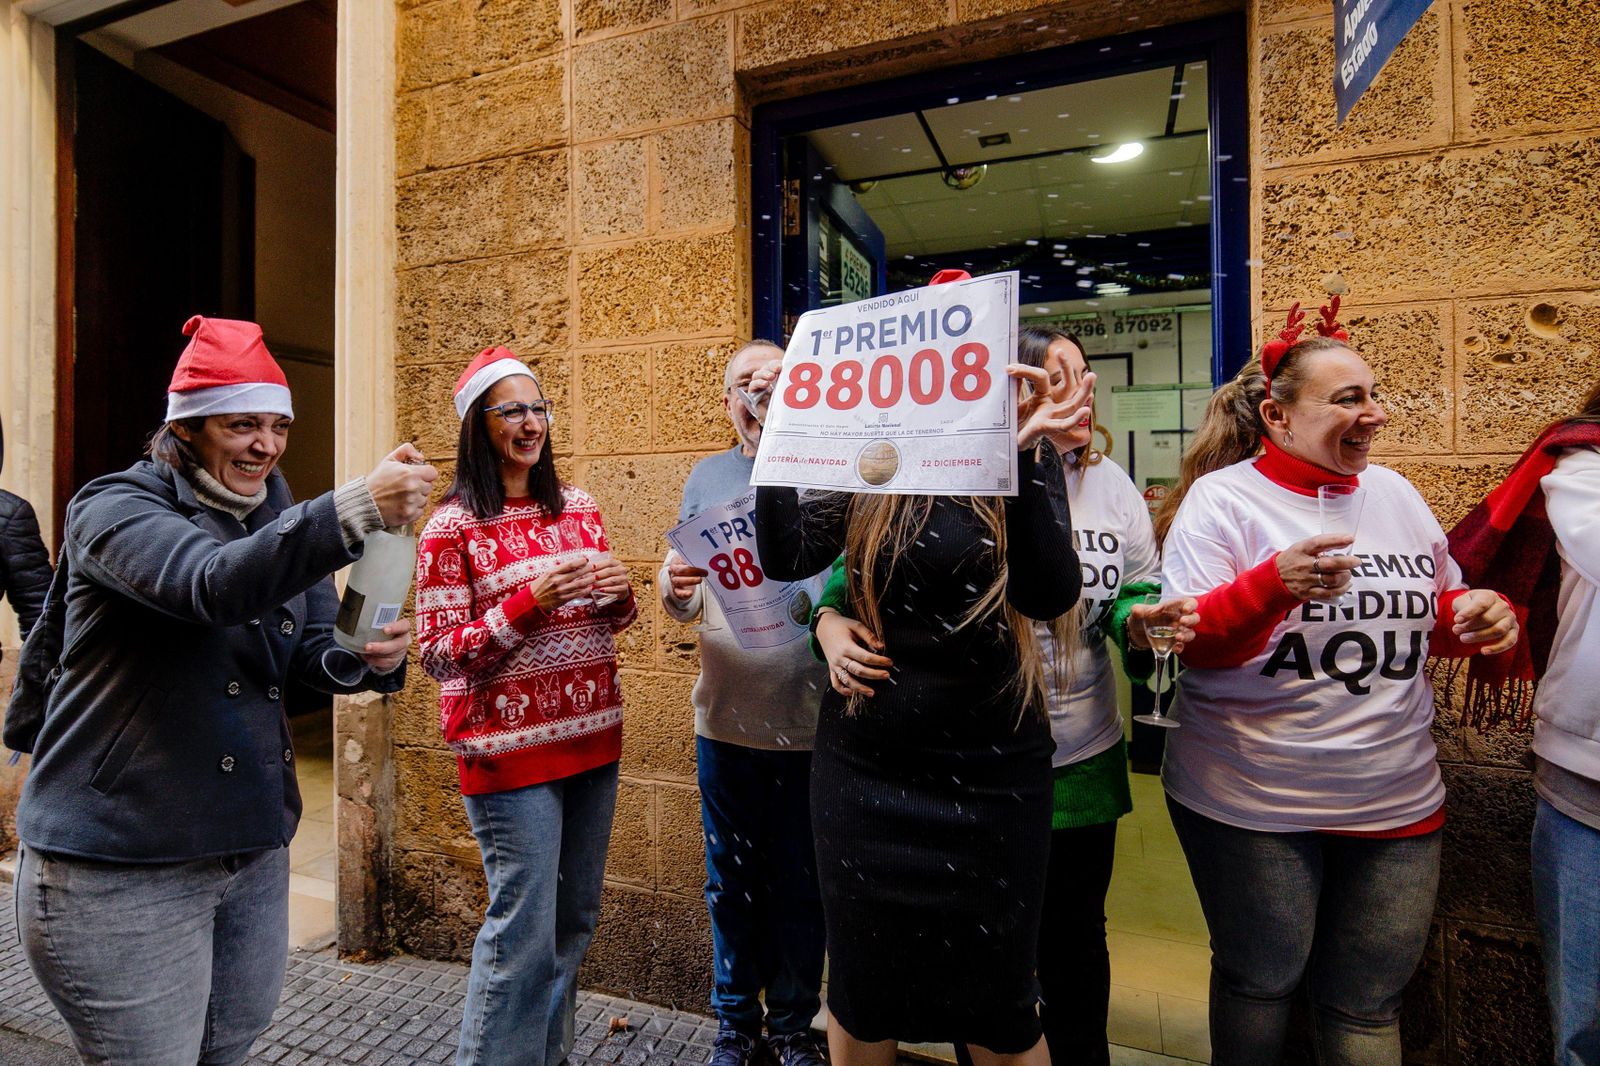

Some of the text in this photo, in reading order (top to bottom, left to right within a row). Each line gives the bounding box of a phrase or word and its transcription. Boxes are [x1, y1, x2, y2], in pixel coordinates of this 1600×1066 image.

[1341, 21, 1378, 90] Estado
[857, 290, 919, 313] VENDIDO AQUÍ
[834, 304, 973, 355] PREMIO
[1114, 318, 1173, 334] 87092
[783, 342, 992, 411] 88008
[767, 454, 798, 463] LOTERÍA
[808, 457, 848, 466] NAVIDAD
[921, 458, 983, 467] 22 DICIEMBRE
[724, 493, 755, 511] VENDIDO
[709, 547, 764, 591] 88
[1333, 553, 1436, 579] EMIO
[1284, 590, 1438, 622] ENDID
[1259, 630, 1433, 696] AQU
